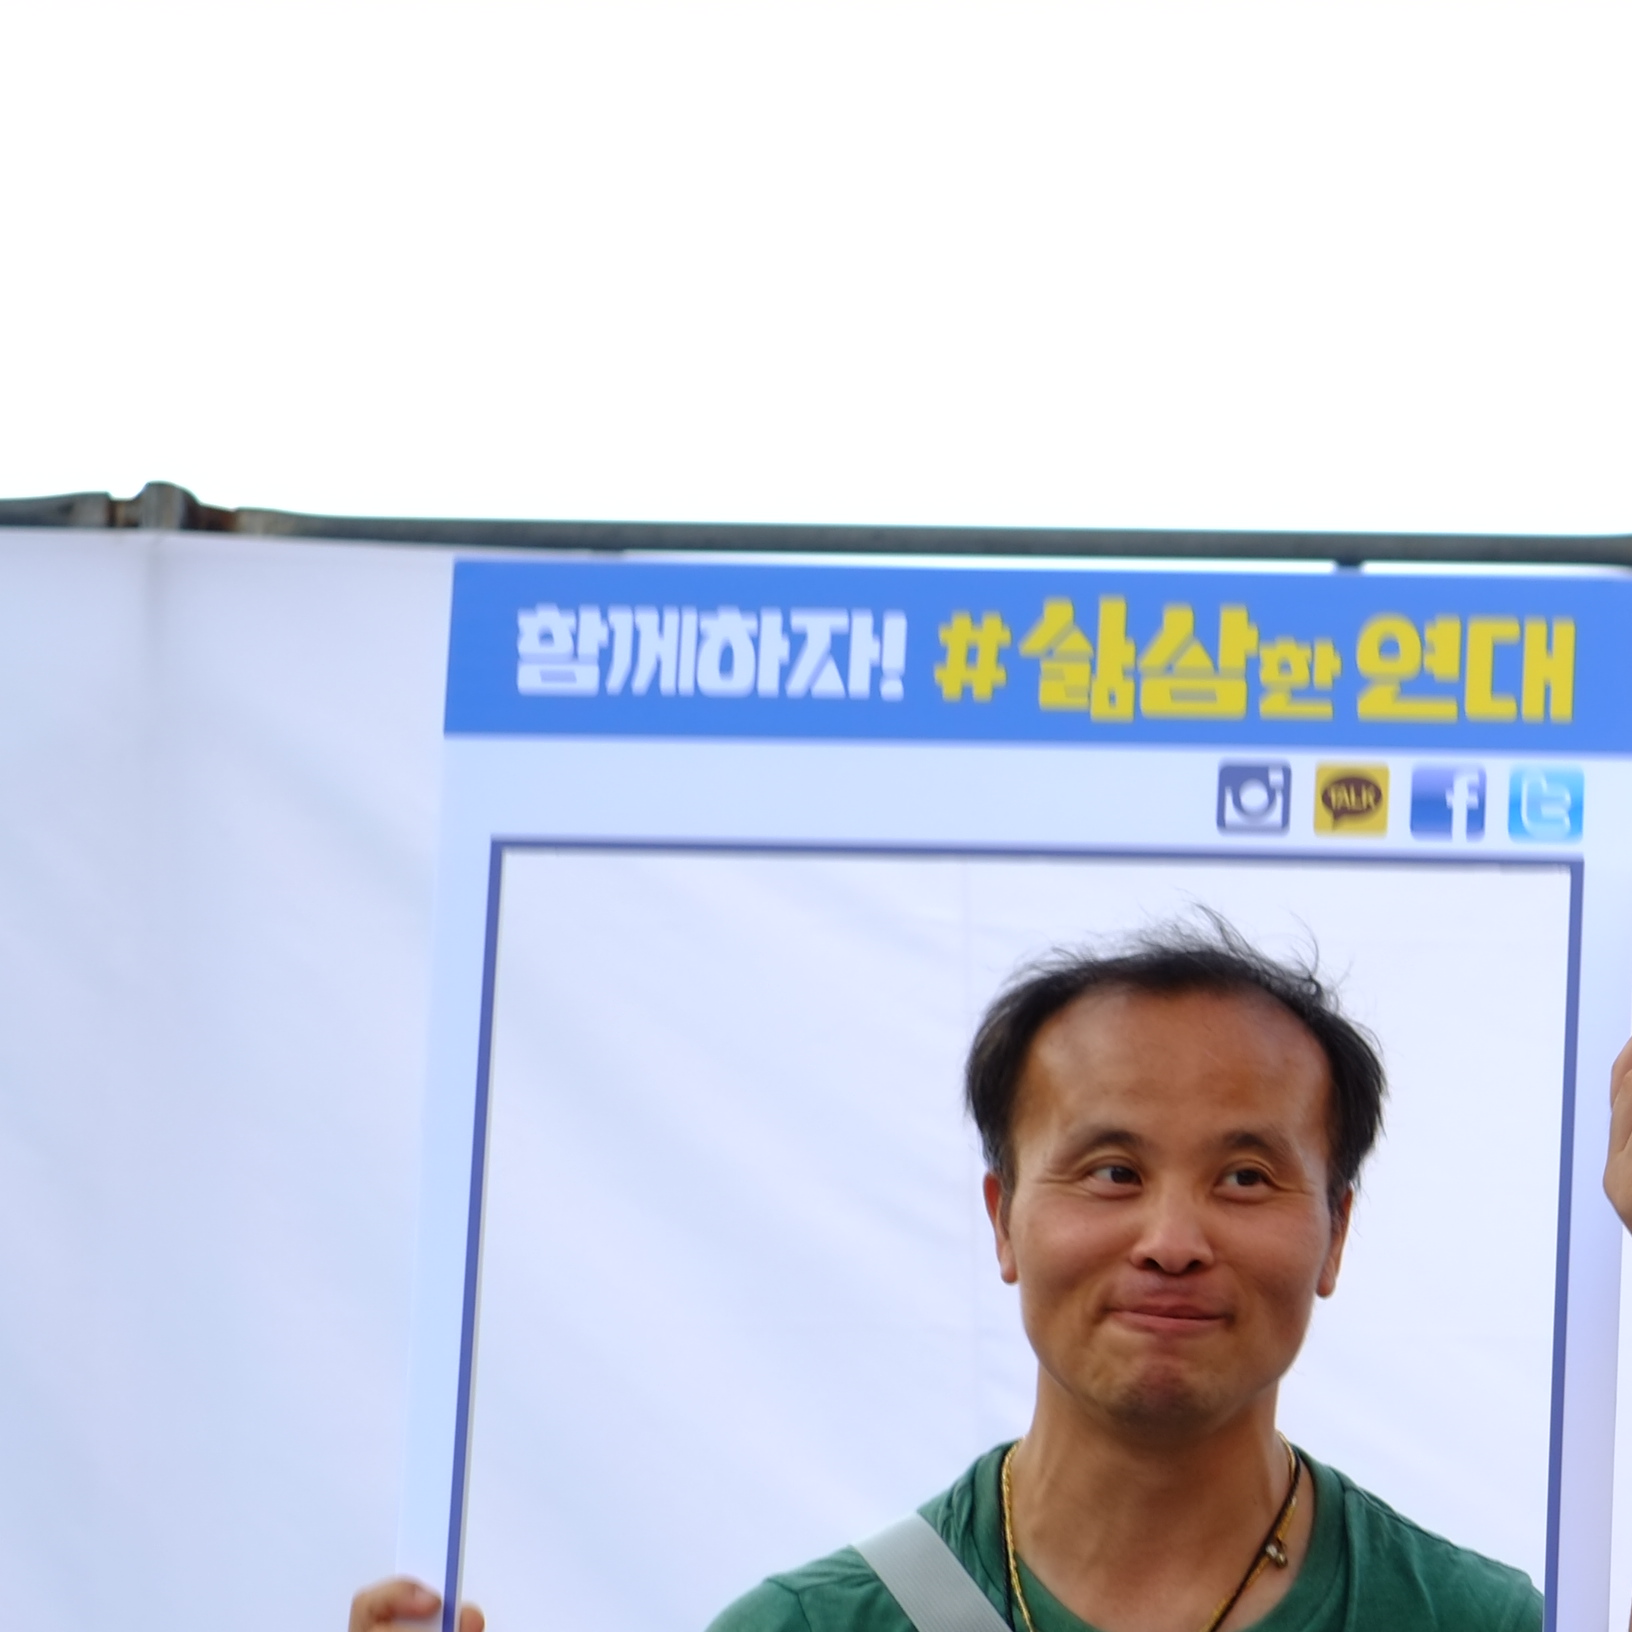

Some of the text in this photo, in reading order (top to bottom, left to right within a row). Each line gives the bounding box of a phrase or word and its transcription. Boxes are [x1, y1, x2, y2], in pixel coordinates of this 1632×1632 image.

[516, 603, 907, 701] 함께하자!
[1356, 613, 1576, 723] 연대
[1328, 781, 1379, 812] TALK
